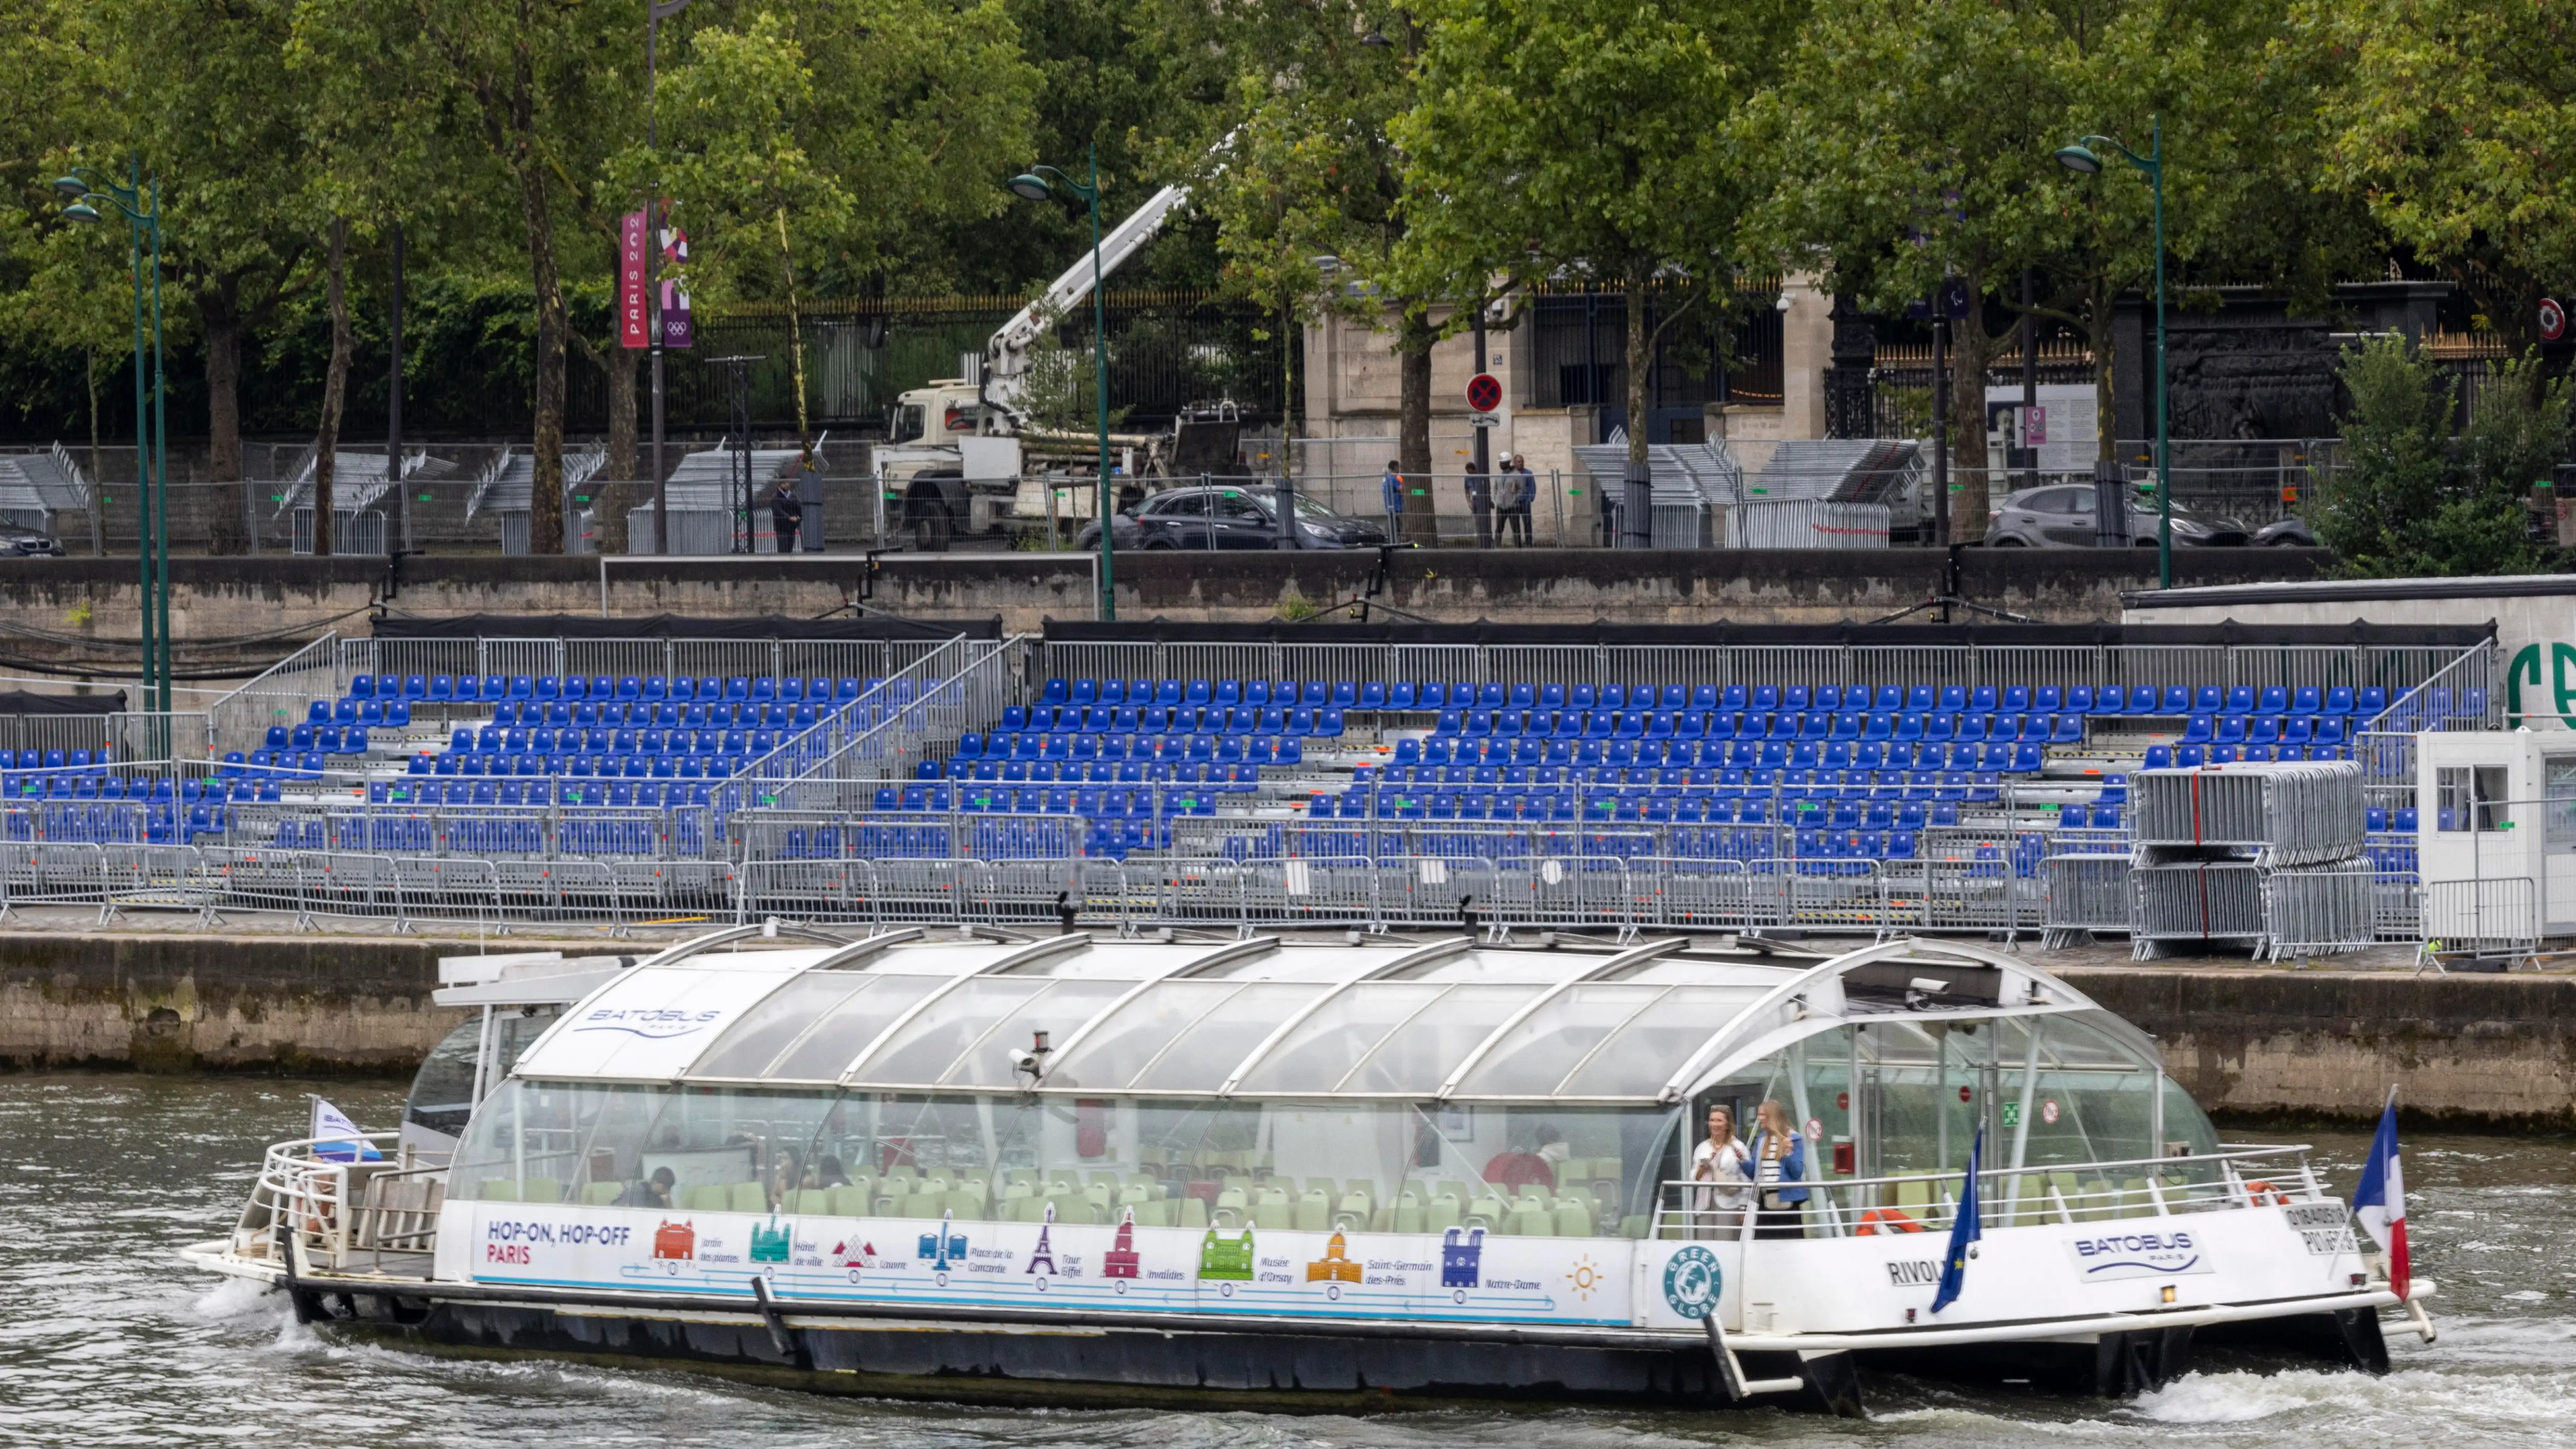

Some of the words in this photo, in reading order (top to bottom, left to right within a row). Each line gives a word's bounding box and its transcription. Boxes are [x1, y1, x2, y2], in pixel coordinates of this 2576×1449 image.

[630, 270, 640, 335] PARIS
[587, 1010, 721, 1022] BATOBUS
[488, 1220, 556, 1247] HOP-ON,
[559, 1224, 631, 1246] HOP-OFF
[487, 1244, 531, 1265] PARIS
[2075, 1233, 2193, 1256] BATOBUS
[879, 1259, 908, 1270] Louvre
[968, 1262, 1007, 1274] Concorde
[1668, 1248, 1720, 1273] GREEN
[1146, 1269, 1185, 1280] Invalides
[1485, 1278, 1542, 1290] Notre-Dame
[1668, 1293, 1718, 1317] GLOBE
